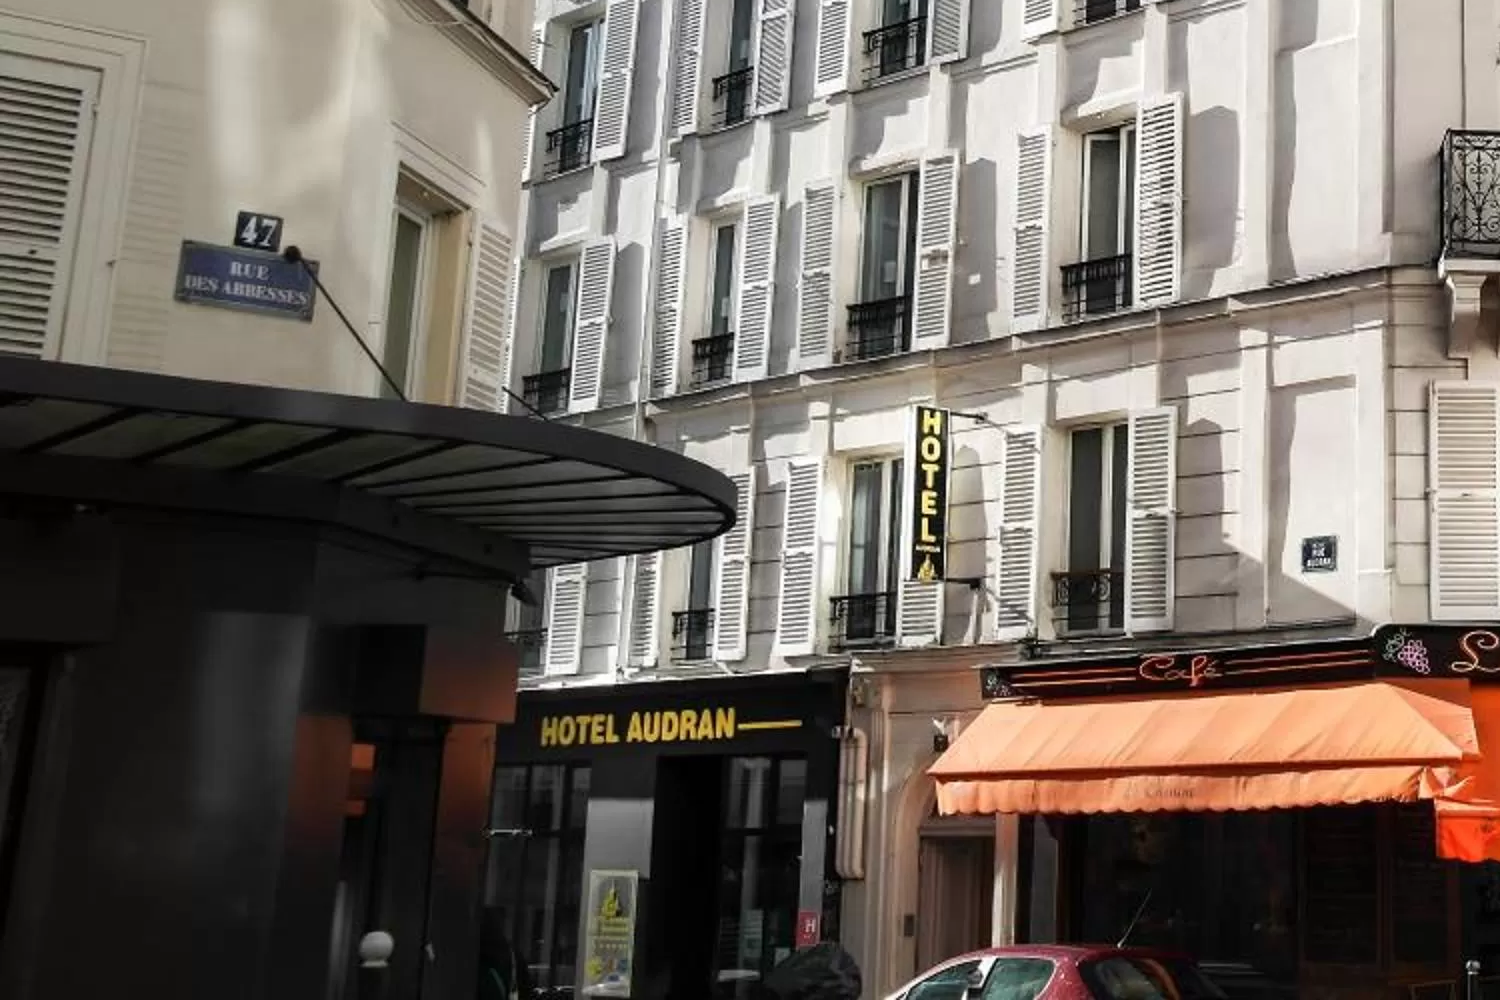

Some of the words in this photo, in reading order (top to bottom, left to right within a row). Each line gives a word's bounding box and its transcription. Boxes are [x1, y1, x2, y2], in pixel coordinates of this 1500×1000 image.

[241, 216, 278, 246] 47
[230, 261, 270, 281] RUE
[184, 275, 219, 291] DES
[222, 281, 307, 305] ABBESSES
[921, 410, 942, 542] HOTEL
[1139, 655, 1223, 687] Café
[540, 714, 620, 747] HOTEL
[626, 707, 736, 743] AUDRAN
